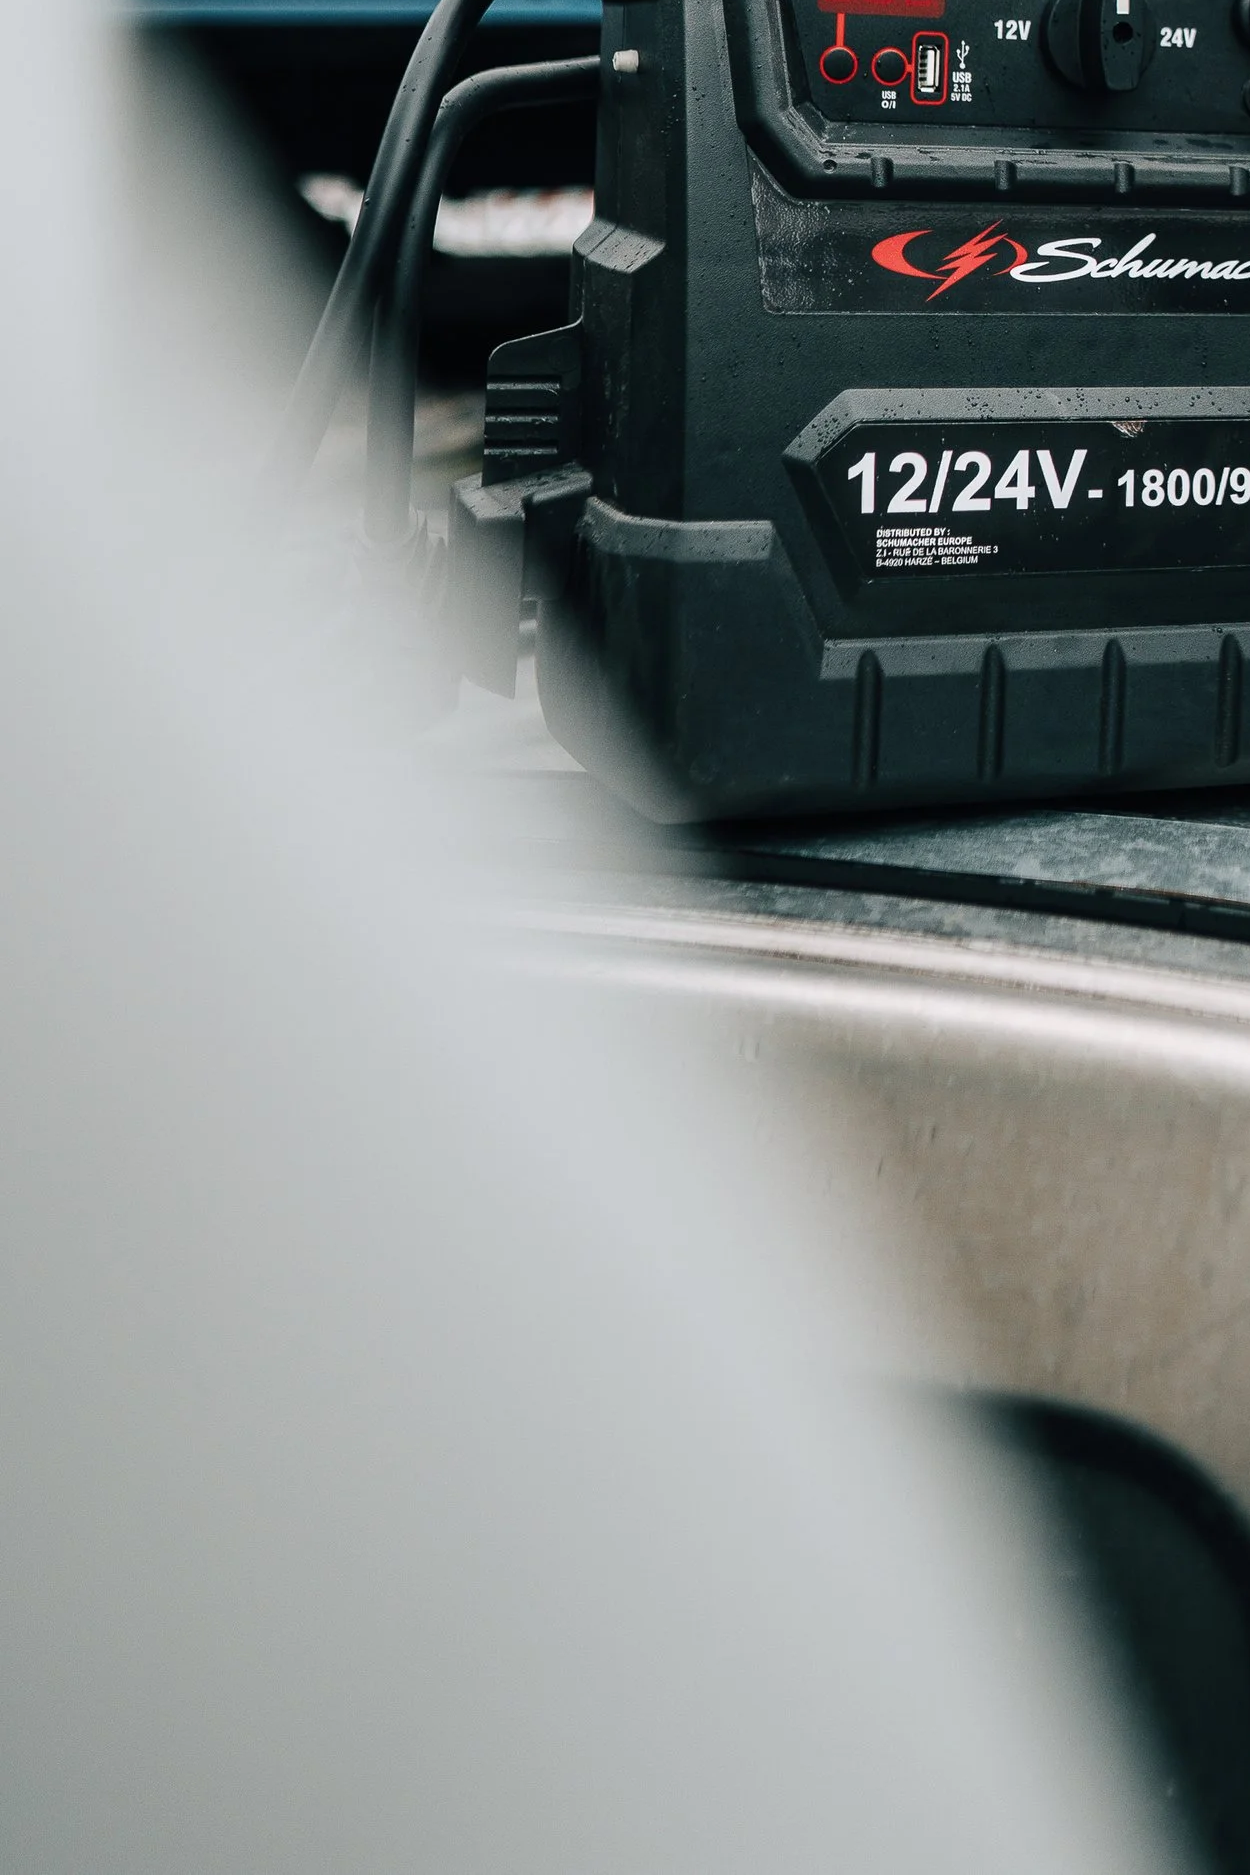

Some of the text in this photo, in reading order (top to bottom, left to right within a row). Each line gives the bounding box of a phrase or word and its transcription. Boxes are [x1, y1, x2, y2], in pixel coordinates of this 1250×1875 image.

[994, 19, 1031, 41] 12V
[1160, 27, 1197, 49] 24V
[952, 72, 972, 83] USB
[953, 84, 970, 92] 2.1A
[882, 91, 897, 100] USB
[951, 93, 972, 102] 5V DC
[876, 527, 932, 538] DISTRIBUTED
[933, 527, 946, 536] BY
[876, 536, 973, 548] SCHUMACHER EUROPE
[892, 547, 911, 557] RUE
[912, 547, 925, 556] DE
[926, 546, 937, 555] LA
[938, 545, 991, 555] BARONNERIE
[993, 545, 999, 554] 3
[876, 557, 903, 567] B-4920
[904, 555, 933, 566] HARZÉ
[941, 555, 978, 565] BELGIUM
